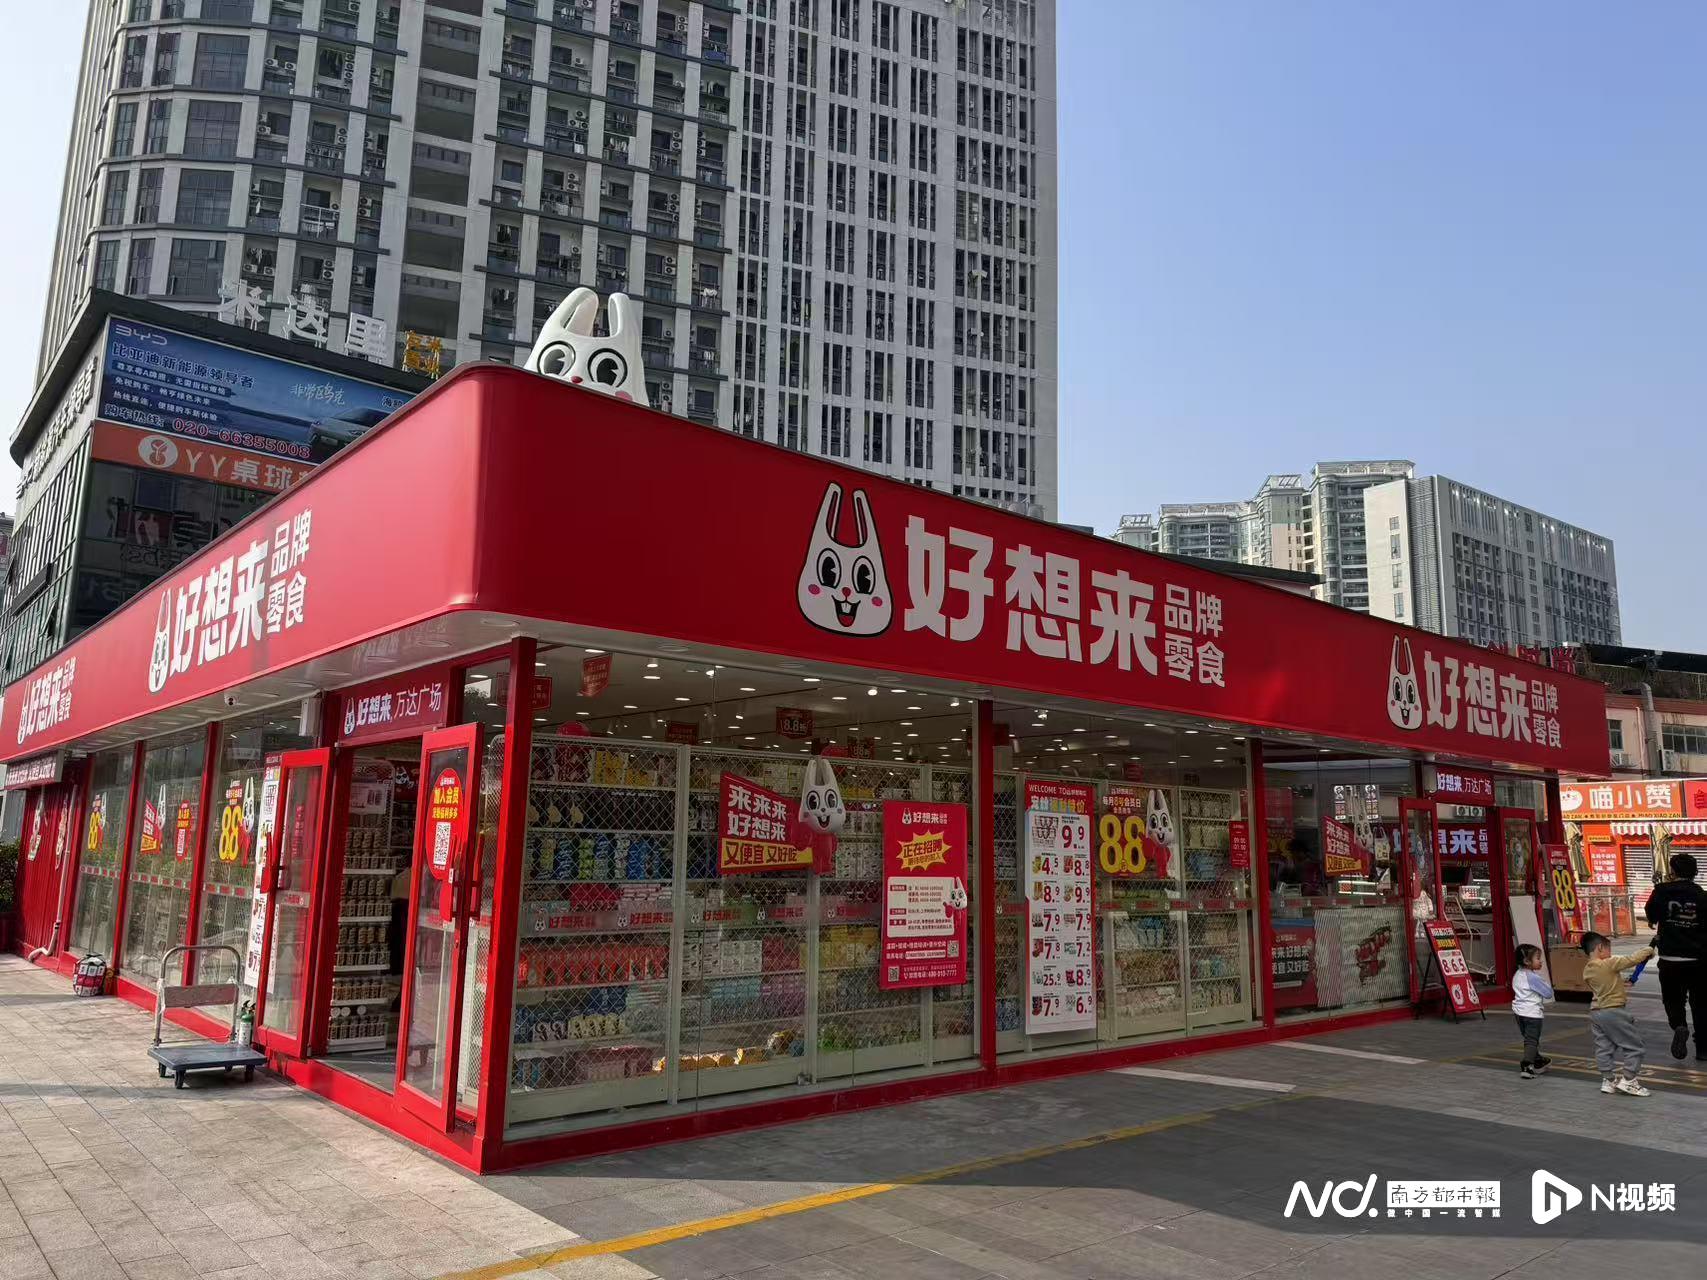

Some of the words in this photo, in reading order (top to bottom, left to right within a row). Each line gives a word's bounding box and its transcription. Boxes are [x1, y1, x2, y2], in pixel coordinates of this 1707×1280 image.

[115, 324, 168, 346] BYD
[111, 341, 256, 389] 比亚迪新能源领导者
[171, 417, 312, 459] 020-66355008
[168, 540, 269, 677] 好想来
[269, 508, 313, 578] 品牌
[265, 570, 308, 634] 零食
[904, 515, 1158, 676] 好想来
[1164, 582, 1224, 638] 品牌
[1164, 632, 1226, 688] 零食
[25, 667, 64, 736] 好想来
[356, 692, 393, 727] 好想来
[393, 682, 442, 720] 万达广场
[1423, 650, 1532, 744] 好想来
[1531, 679, 1559, 714] 品牌
[1533, 713, 1562, 749] 零食
[433, 786, 460, 804] 加入会员
[1029, 784, 1057, 794] WELCOME
[1059, 787, 1067, 795] TO
[1436, 772, 1462, 793] 好想来
[1463, 777, 1492, 795] 万达广场
[1588, 783, 1673, 810] 喵小赞
[728, 784, 787, 821] 来来来
[912, 811, 940, 824] 好想来
[1102, 796, 1141, 808] 每月8号会员日
[727, 810, 787, 842] 好想来
[724, 841, 765, 866] 又便宜
[766, 845, 798, 864] 又好吃
[903, 838, 943, 859] 正在招聘
